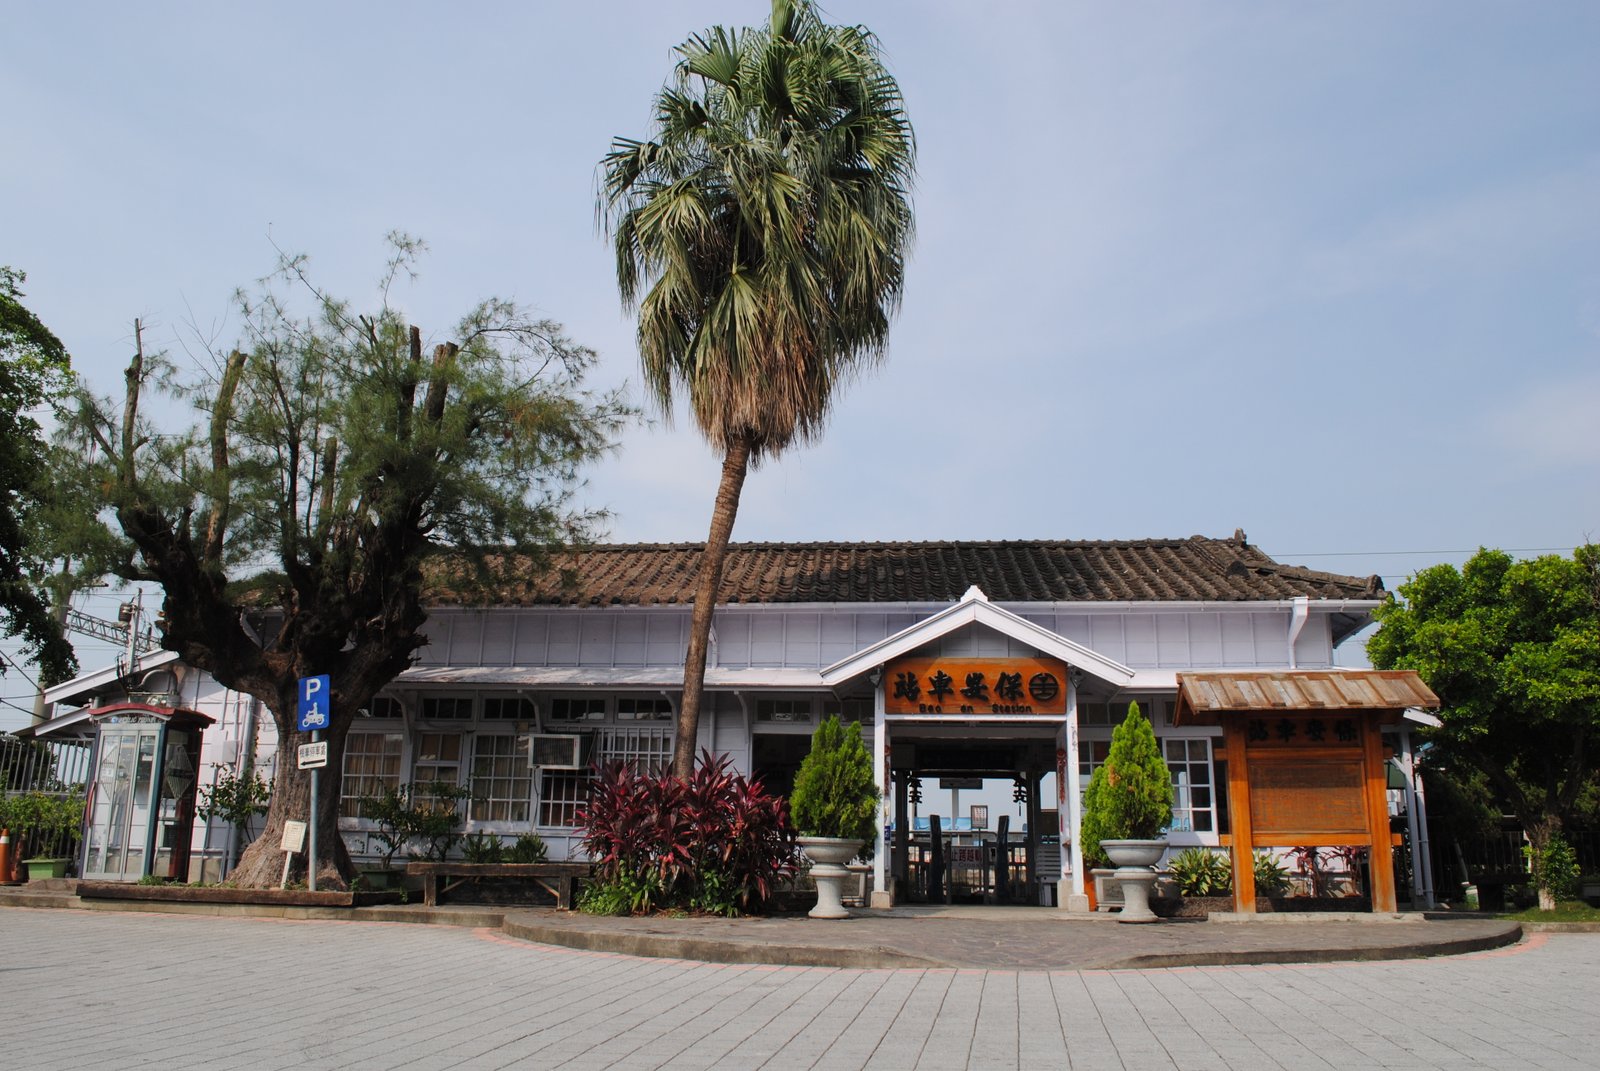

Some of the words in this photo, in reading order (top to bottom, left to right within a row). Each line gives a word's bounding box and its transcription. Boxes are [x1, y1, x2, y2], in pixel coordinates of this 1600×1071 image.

[306, 678, 321, 701] P
[919, 704, 942, 713] Bao
[960, 704, 974, 713] an
[992, 703, 1032, 713] Station
